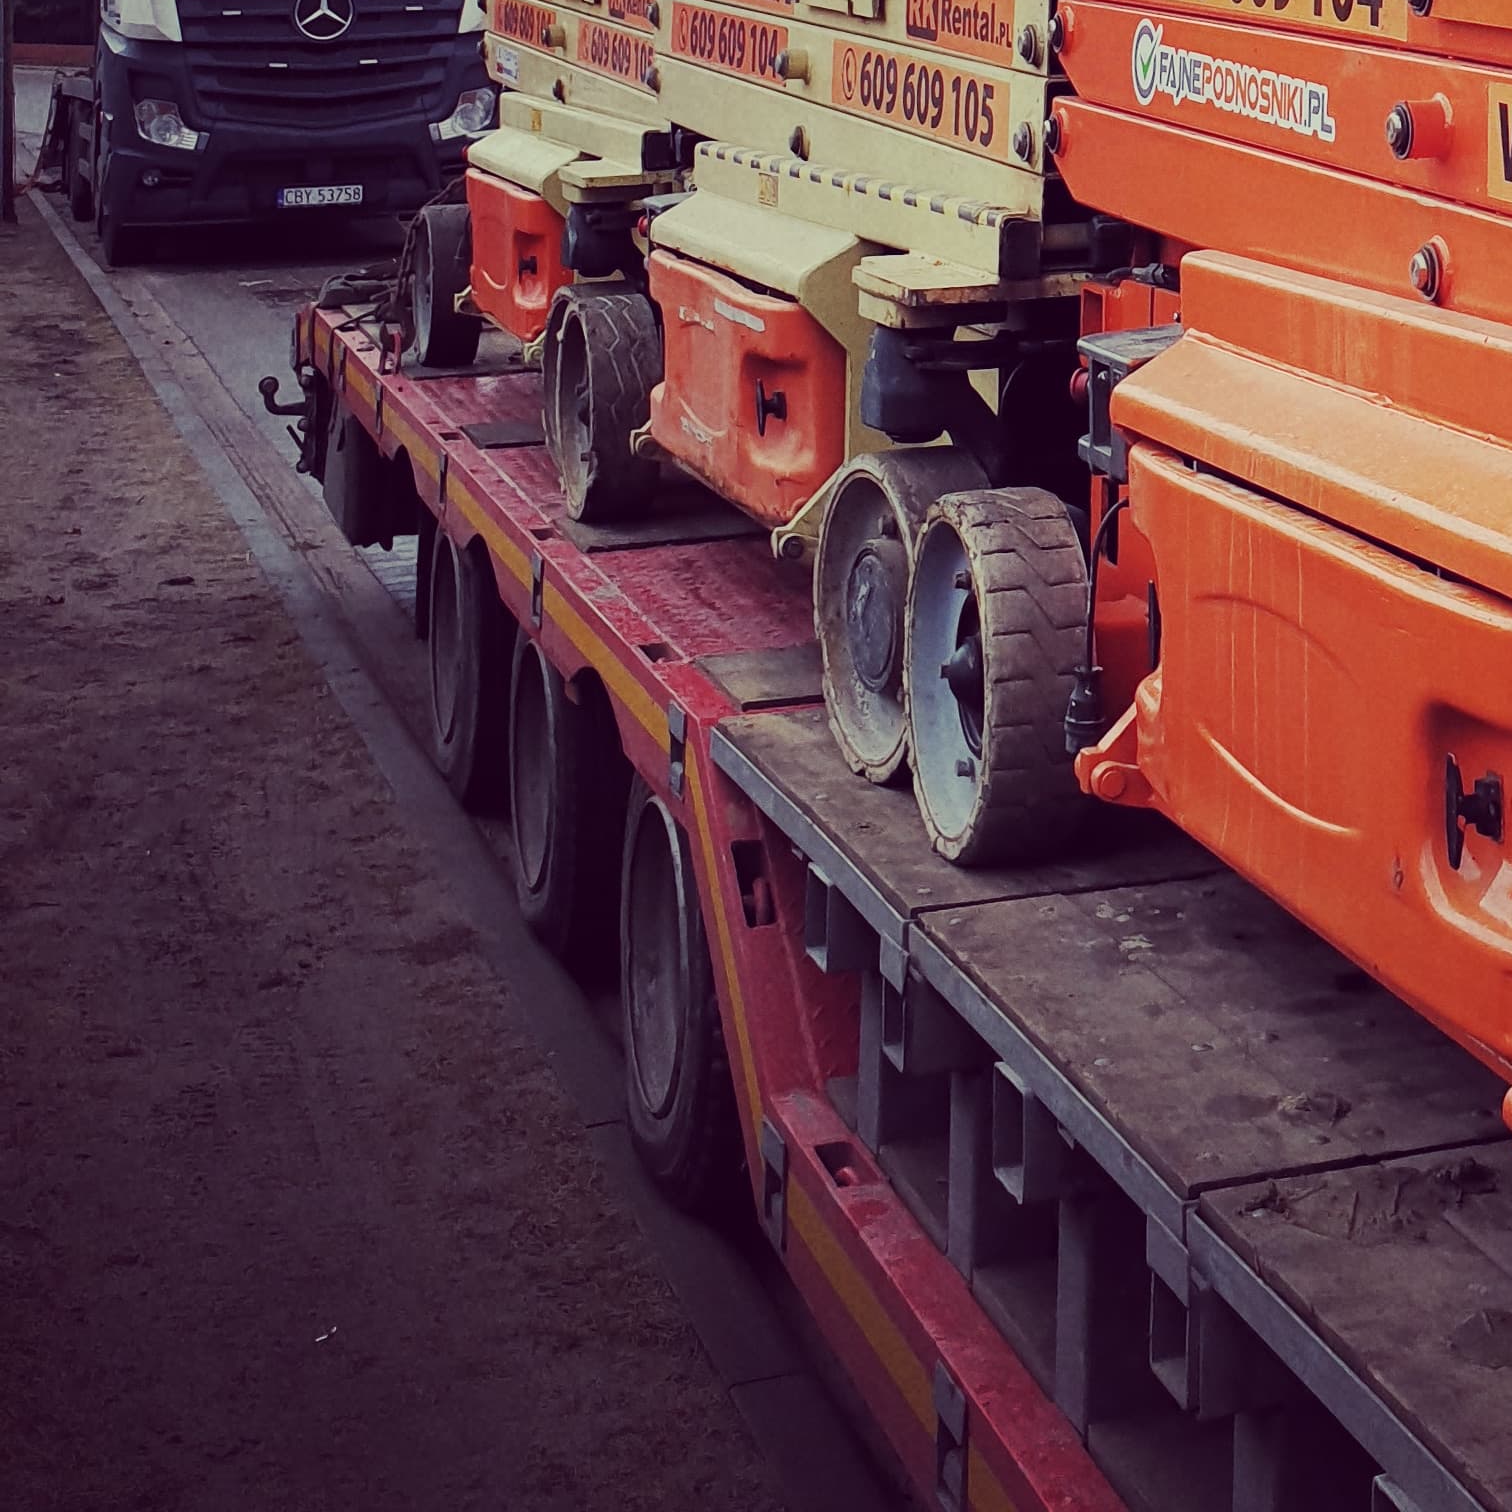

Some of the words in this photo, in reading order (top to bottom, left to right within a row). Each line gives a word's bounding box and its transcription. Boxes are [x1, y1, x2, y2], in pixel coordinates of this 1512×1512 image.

[690, 10, 716, 60] 609
[719, 17, 746, 69] 609
[751, 24, 779, 79] 104
[860, 51, 898, 114] 609
[903, 62, 945, 129] 609
[952, 75, 995, 148] 105
[1160, 50, 1333, 134] FAJNEPODNOSNIKI.PL
[285, 189, 312, 204] CBY
